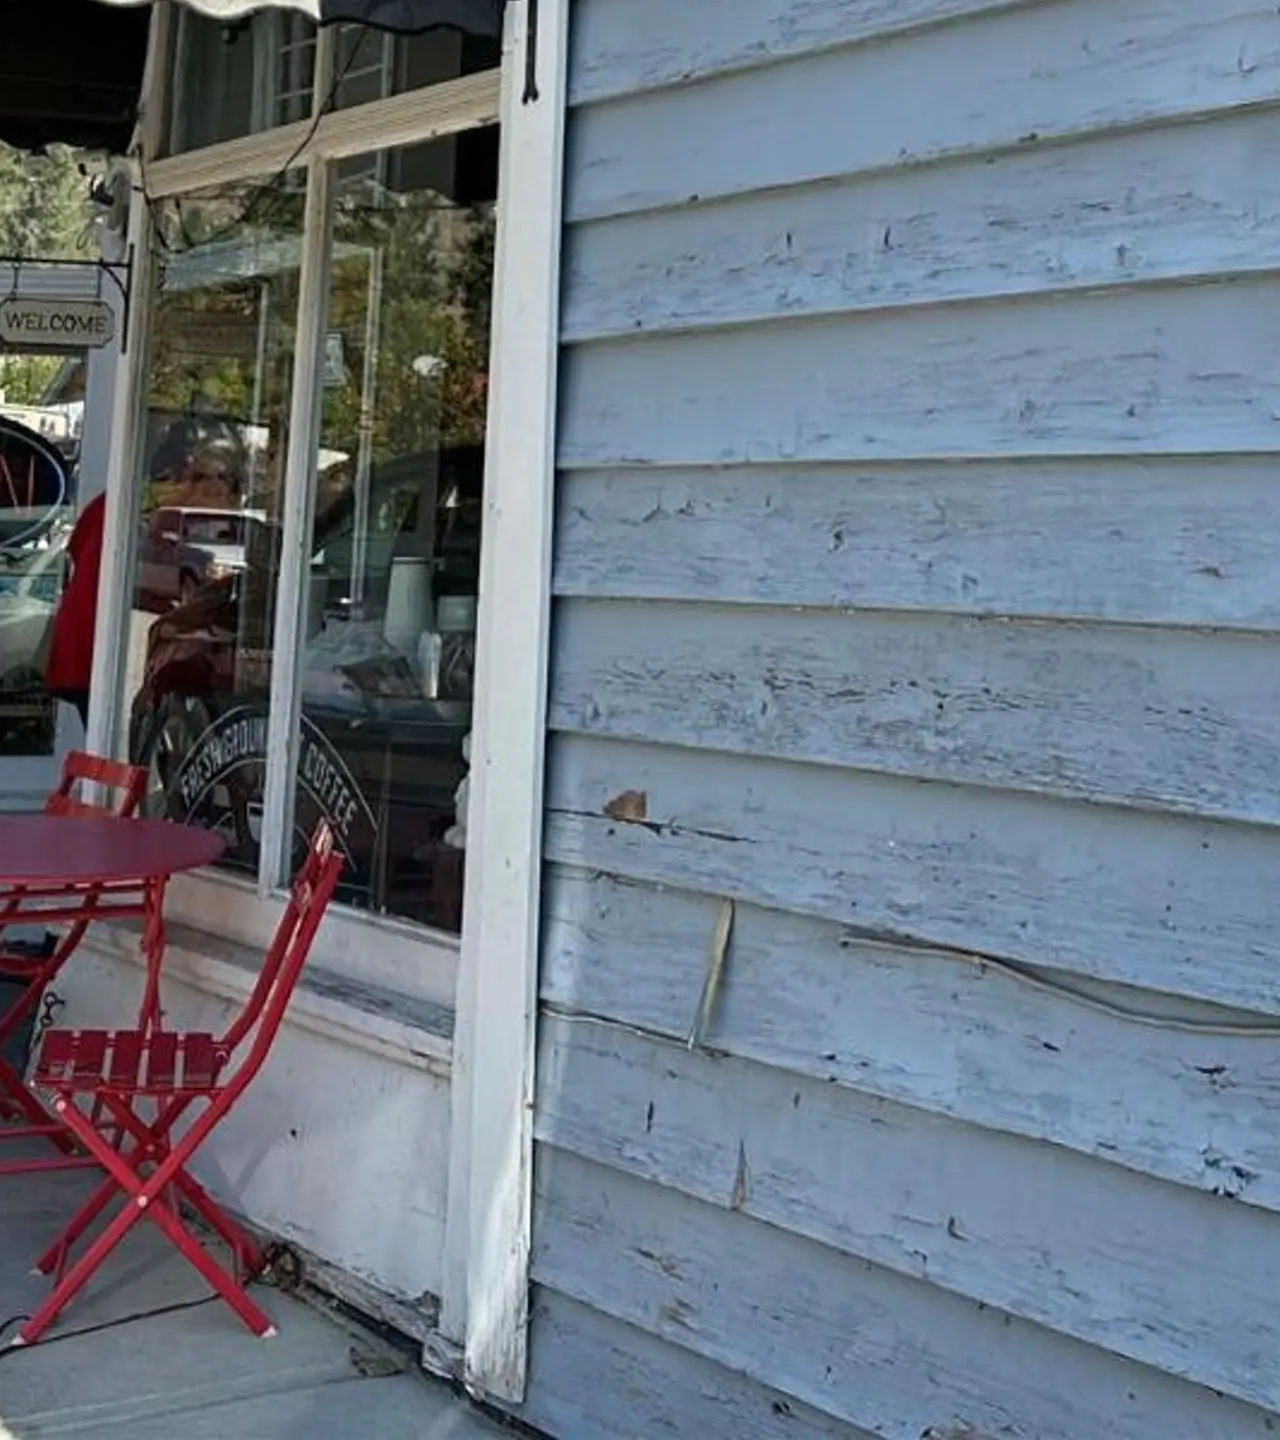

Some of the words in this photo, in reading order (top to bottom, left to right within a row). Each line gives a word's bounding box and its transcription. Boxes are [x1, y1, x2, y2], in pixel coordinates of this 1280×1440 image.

[5, 312, 109, 333] WELCOME
[180, 738, 223, 810] FRESH
[303, 741, 359, 837] COFFEE
